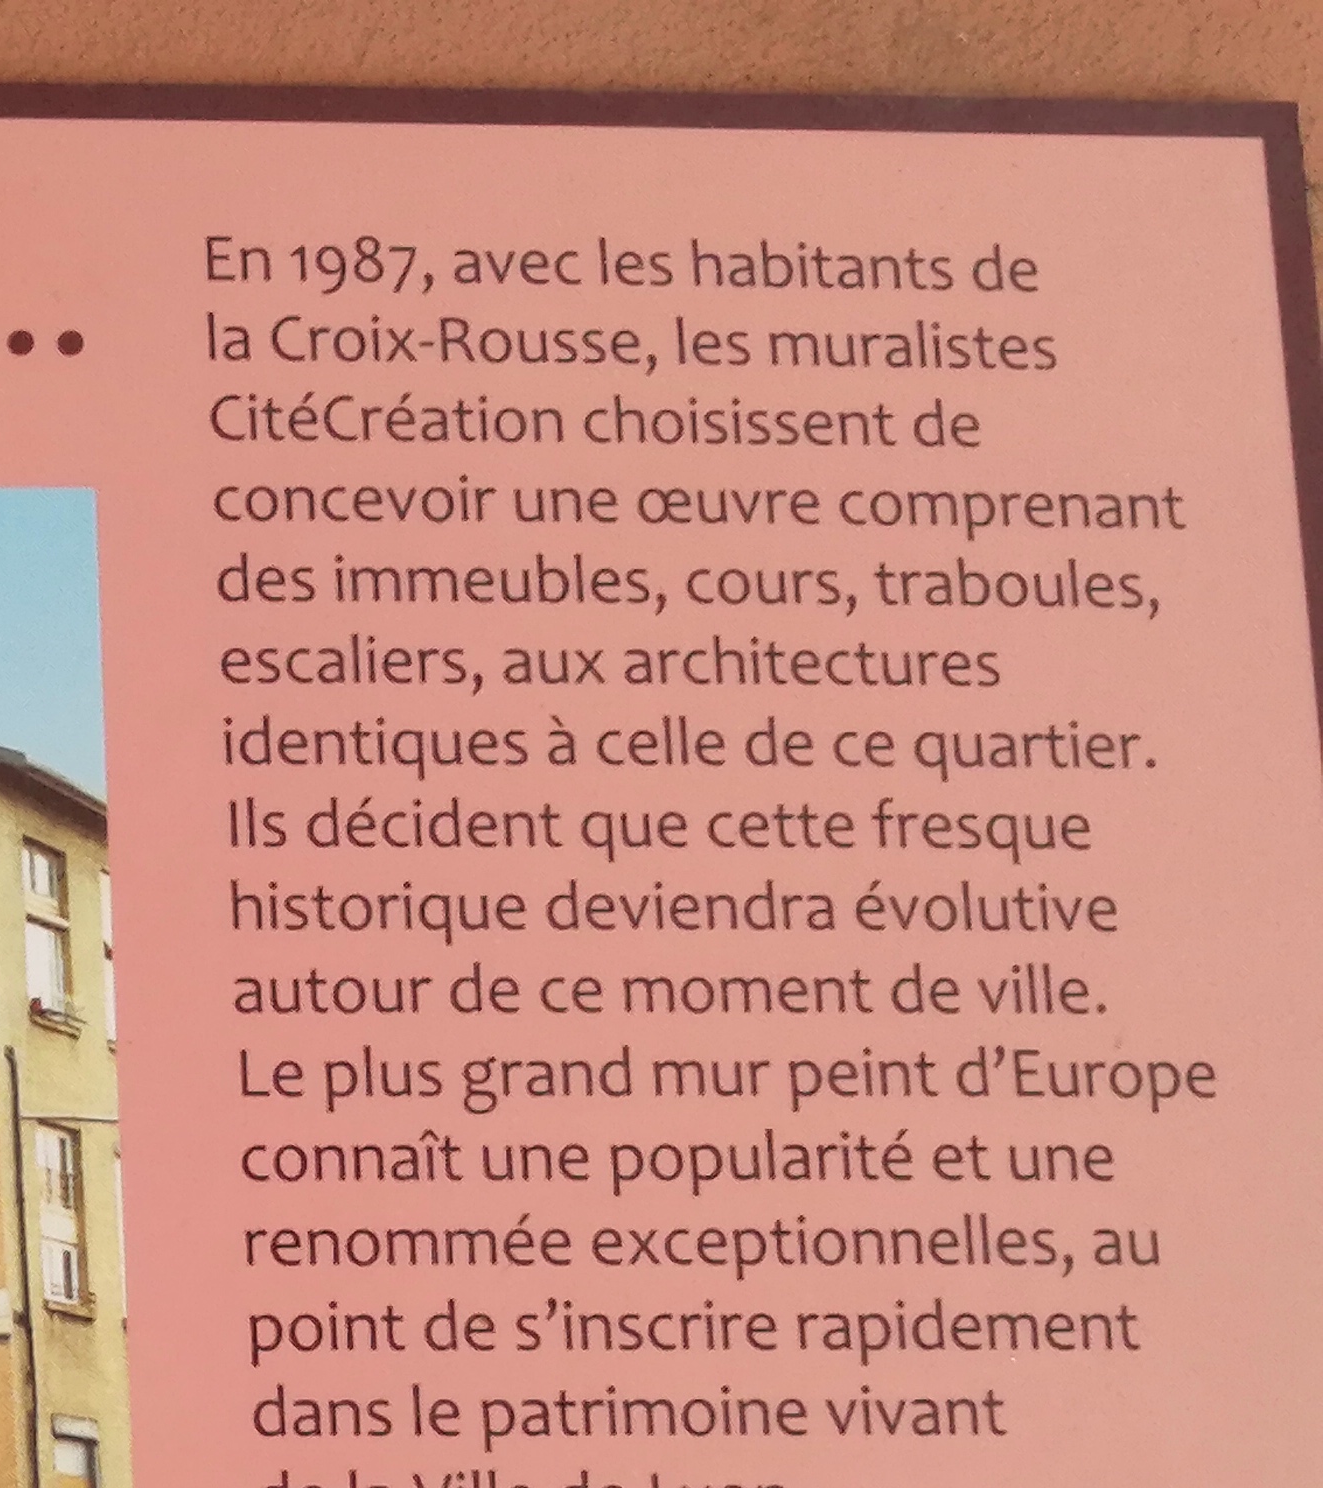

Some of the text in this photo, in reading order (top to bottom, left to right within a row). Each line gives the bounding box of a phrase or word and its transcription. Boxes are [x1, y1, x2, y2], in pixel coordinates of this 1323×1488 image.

[205, 235, 1038, 295] En 1987, avec les habitants de
[207, 312, 1057, 376] la Croix-Rousse, les muralistes
[210, 391, 980, 448] CitéCréation choisissent de
[214, 474, 1186, 541] concevoir une œuvre comprenant
[217, 552, 1159, 620] des immeubles, cours, traboules,
[221, 633, 1000, 696] escaliers, aux architectures
[229, 796, 1091, 865] Ils décident que cette fresque
[230, 879, 1117, 946] historique deviendra évolutive
[240, 1045, 1216, 1115] Le plus grand mur peint d'Europe
[241, 1128, 1114, 1197] connaît une popularité et une
[245, 1213, 1160, 1281] renommée exceptionnelles, au
[249, 1297, 1140, 1368] point de s'inscrire rapidement
